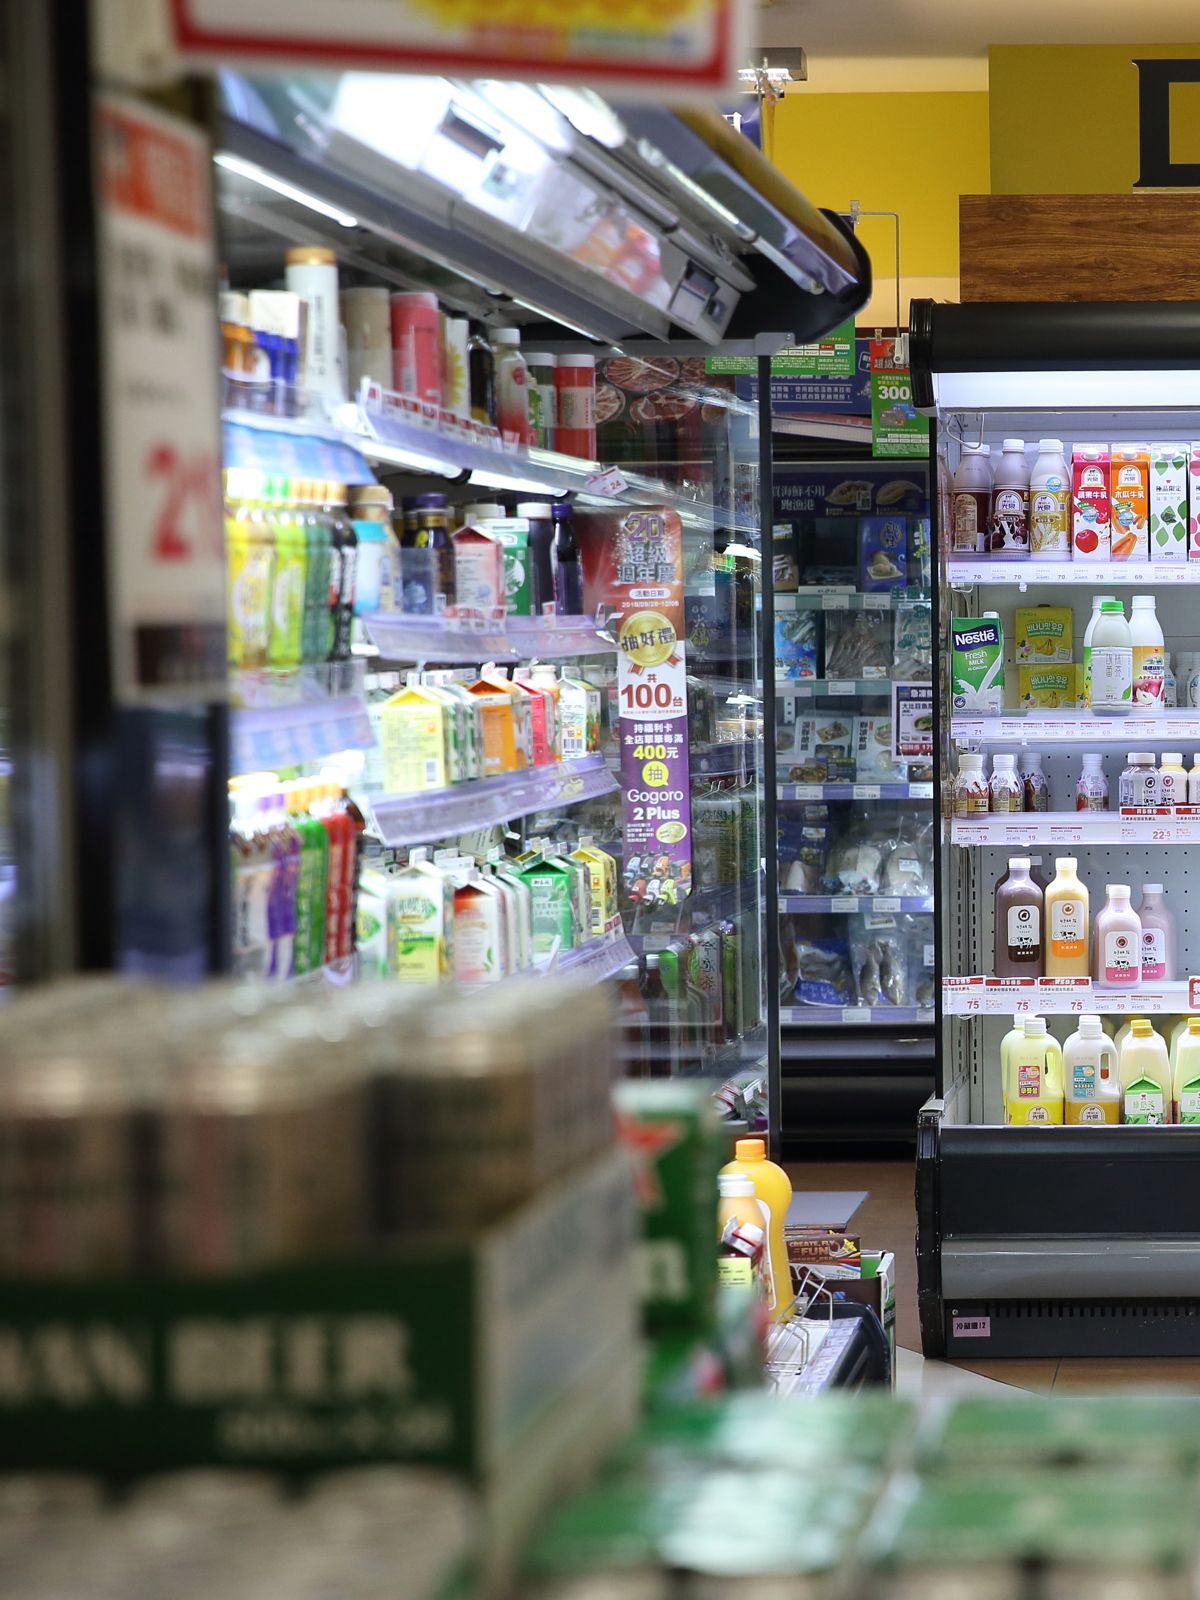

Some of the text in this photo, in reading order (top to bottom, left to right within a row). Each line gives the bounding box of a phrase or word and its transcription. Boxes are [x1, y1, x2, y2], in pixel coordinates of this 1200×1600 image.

[965, 651, 988, 660] Fresh
[627, 788, 684, 804] Gogoro
[633, 806, 680, 821] 2 Plus
[967, 1000, 979, 1009] 75
[1016, 1001, 1029, 1011] 75
[1070, 1001, 1083, 1010] 75
